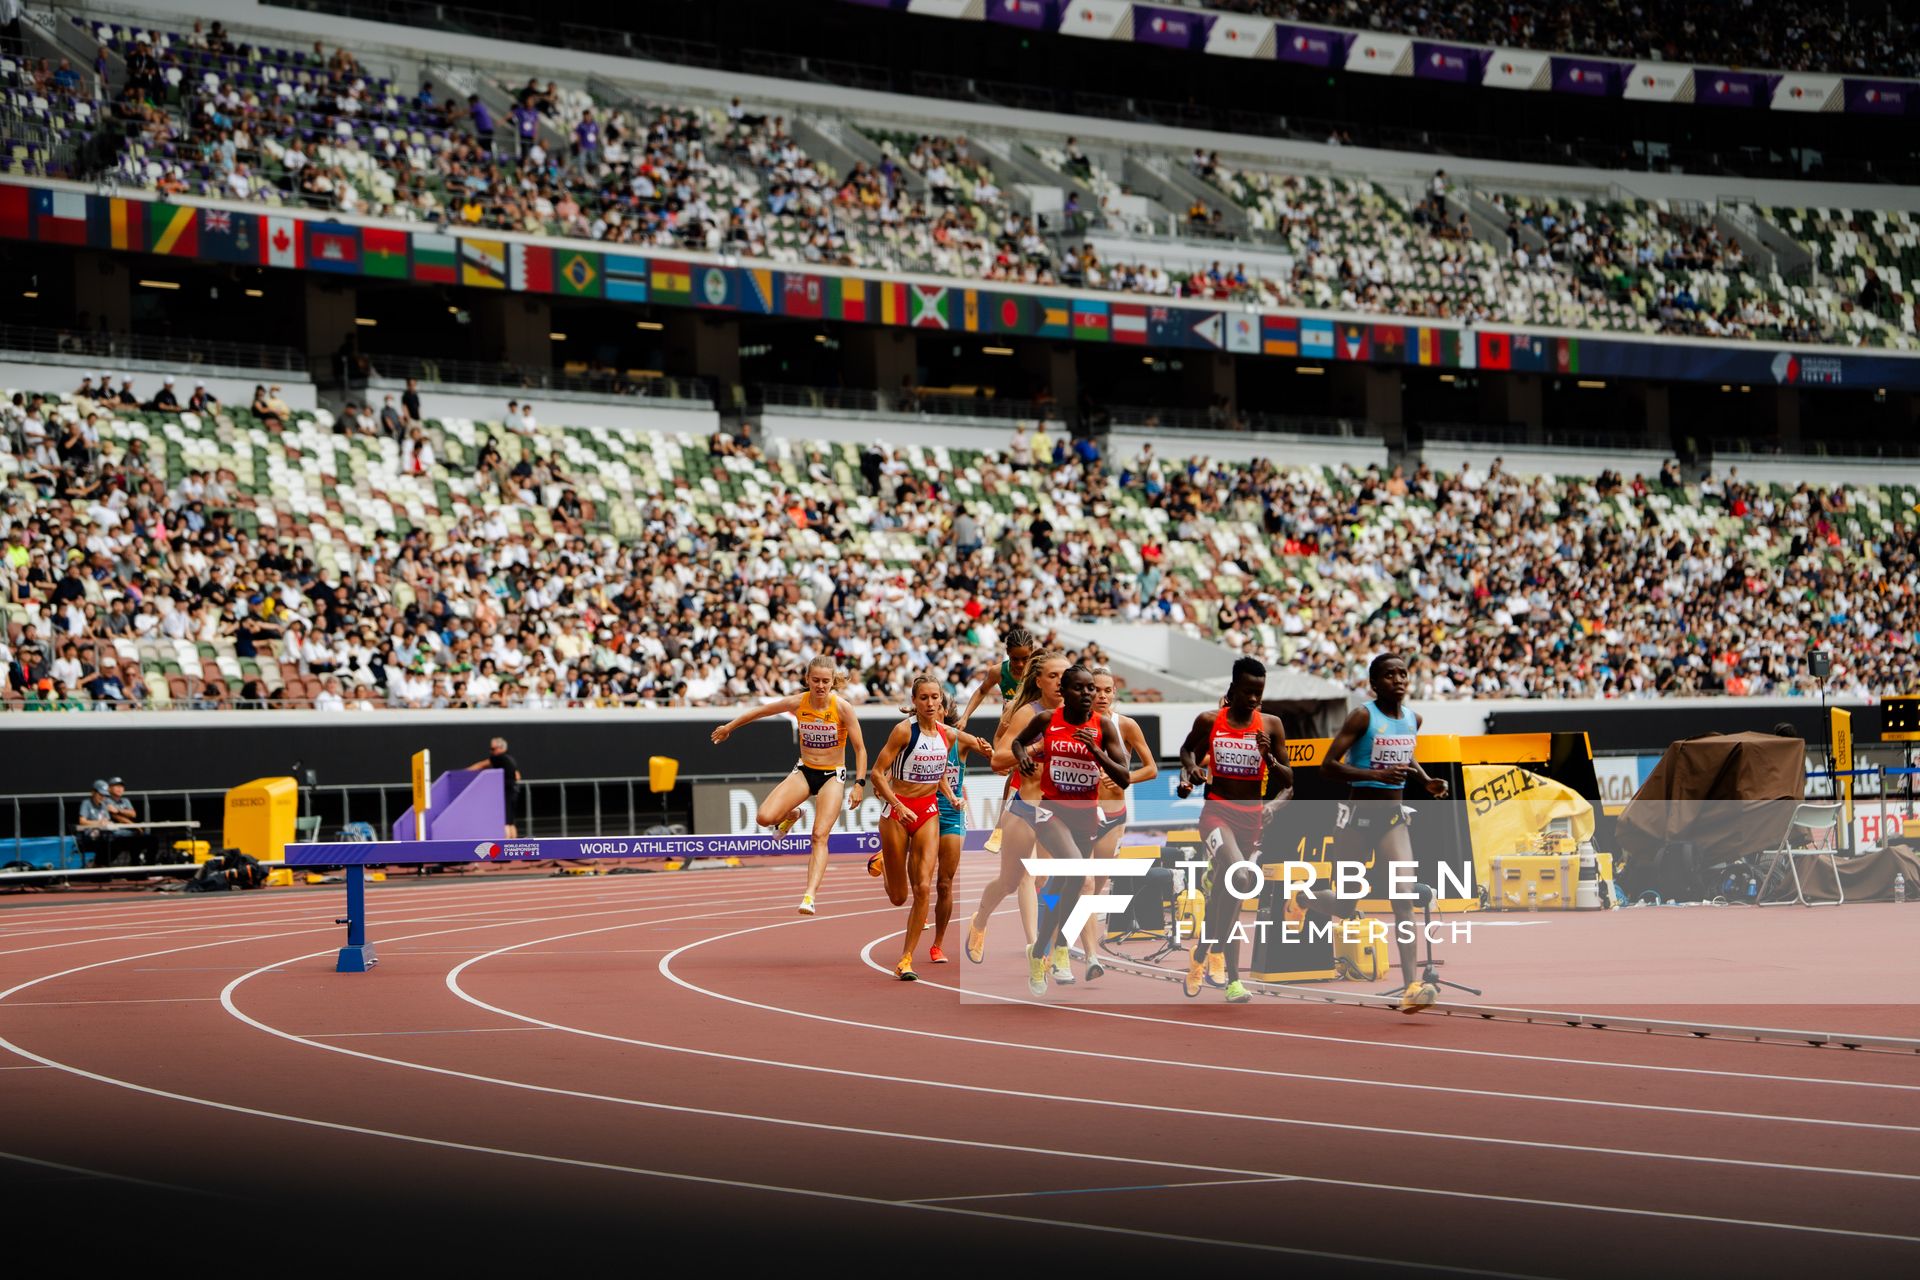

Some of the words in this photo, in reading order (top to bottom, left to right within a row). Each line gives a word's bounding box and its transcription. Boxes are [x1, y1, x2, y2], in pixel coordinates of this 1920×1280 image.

[800, 723, 836, 731] HONDA
[1051, 740, 1089, 755] KENY
[1375, 737, 1416, 746] HONDA
[1837, 730, 1846, 765] SEIKO
[913, 754, 947, 762] HONDA
[1215, 751, 1261, 768] CHEROTICH
[1286, 744, 1315, 762] IKO
[1052, 759, 1098, 772] HONDA
[1053, 770, 1098, 785] BIWOT
[579, 842, 629, 855] WORLD
[632, 840, 705, 853] ATHLETICS
[707, 838, 813, 852] CHAMPIONSHIP
